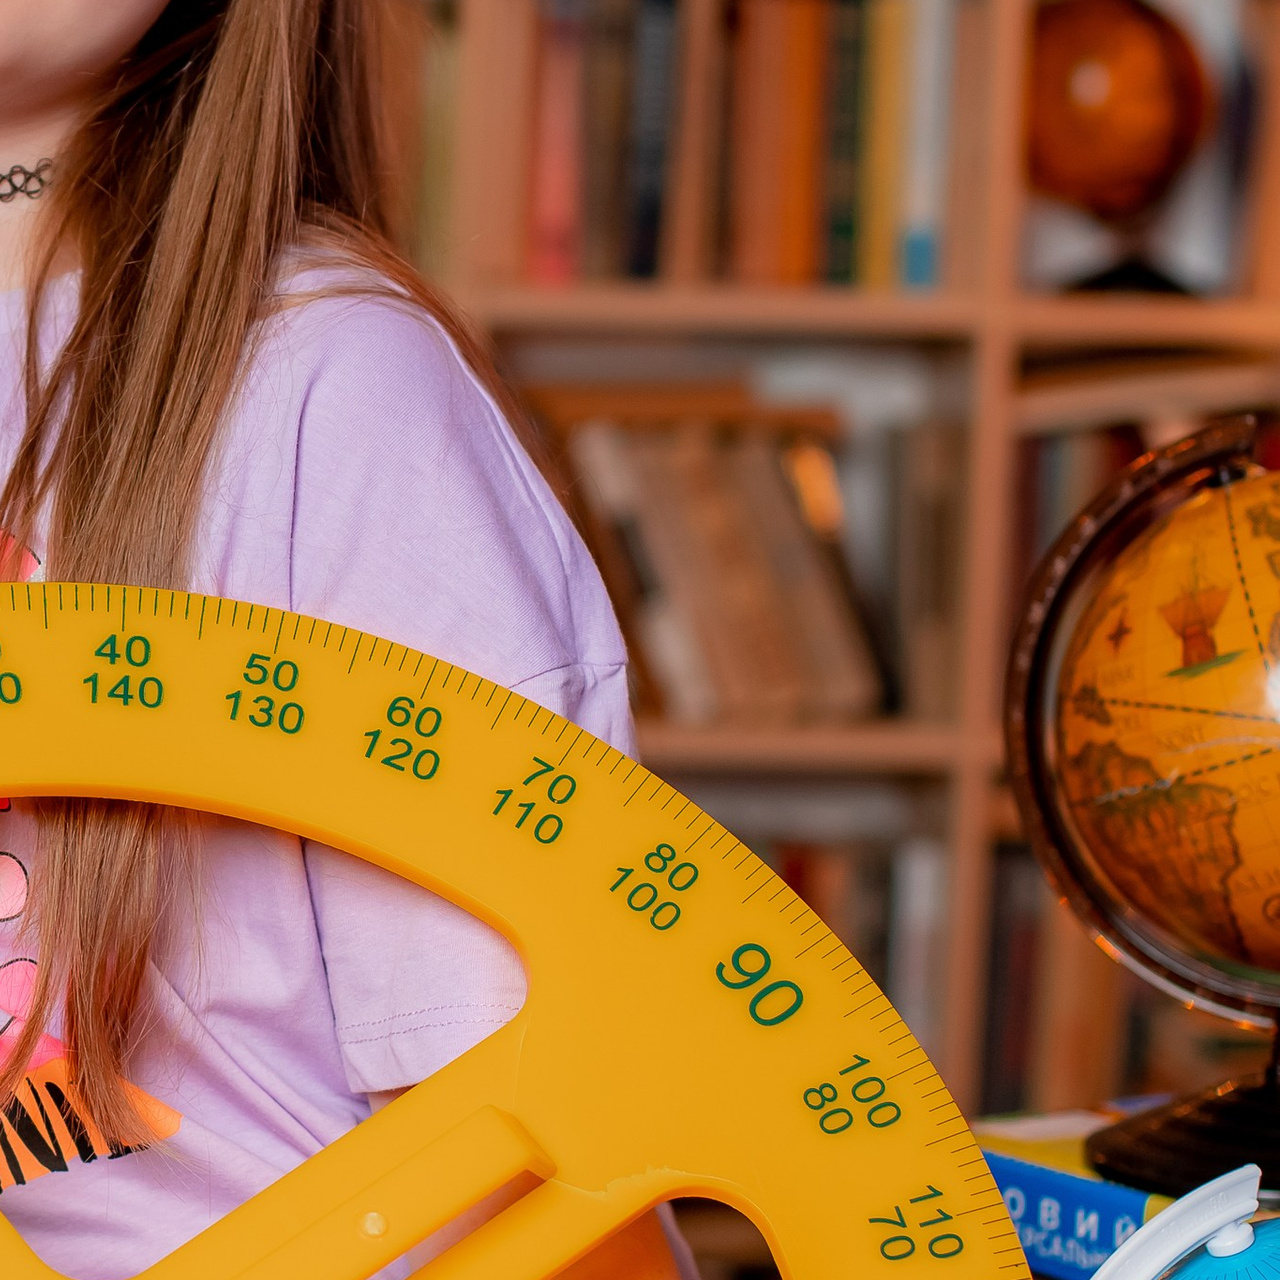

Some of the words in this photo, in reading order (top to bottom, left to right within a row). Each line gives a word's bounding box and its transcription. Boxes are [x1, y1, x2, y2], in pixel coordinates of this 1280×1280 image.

[95, 634, 151, 667] 40
[243, 653, 299, 692] 50
[83, 673, 164, 708] 140
[226, 689, 305, 734] 130
[387, 696, 442, 738] 60
[364, 729, 440, 780] 120
[522, 757, 576, 805] 70
[493, 787, 564, 844] 110
[644, 843, 699, 891] 80
[610, 866, 681, 931] 100
[716, 943, 804, 1026] 90
[803, 1083, 853, 1134] 80
[839, 1054, 901, 1128] 100
[869, 1206, 915, 1261] 70
[908, 1185, 964, 1259] 110
